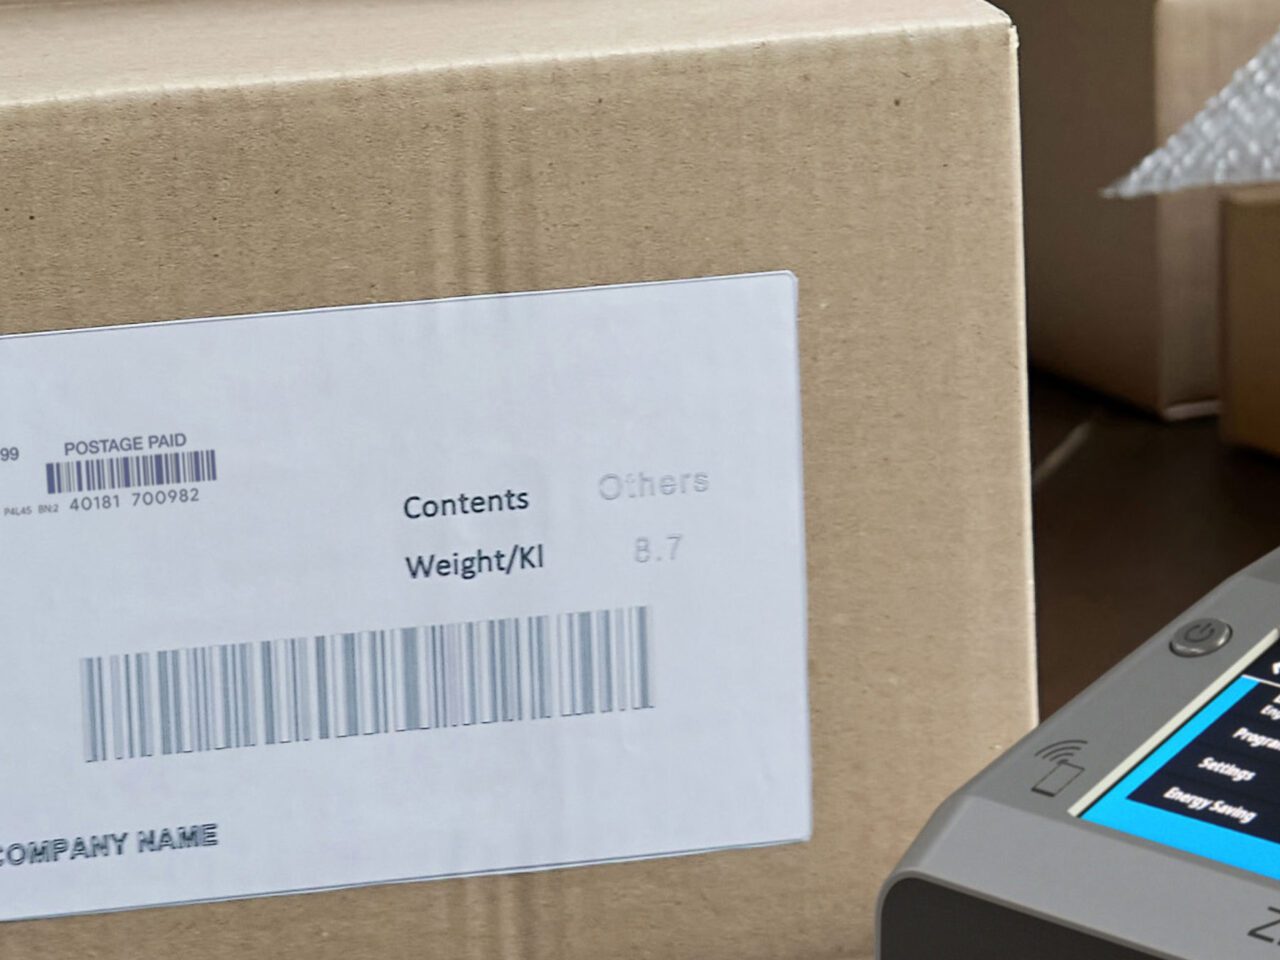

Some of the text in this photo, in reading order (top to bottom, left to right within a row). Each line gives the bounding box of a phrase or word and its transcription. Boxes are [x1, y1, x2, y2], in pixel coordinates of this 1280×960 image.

[64, 433, 187, 456] POSTAGE PAID
[69, 488, 200, 511] 40181 700982
[598, 471, 710, 501] Others
[403, 489, 529, 519] Contents
[634, 534, 683, 563] 8.7
[1198, 757, 1256, 782] Settings
[1163, 787, 1257, 823] Energy Saving
[0, 823, 218, 867] OMPANY NAME
